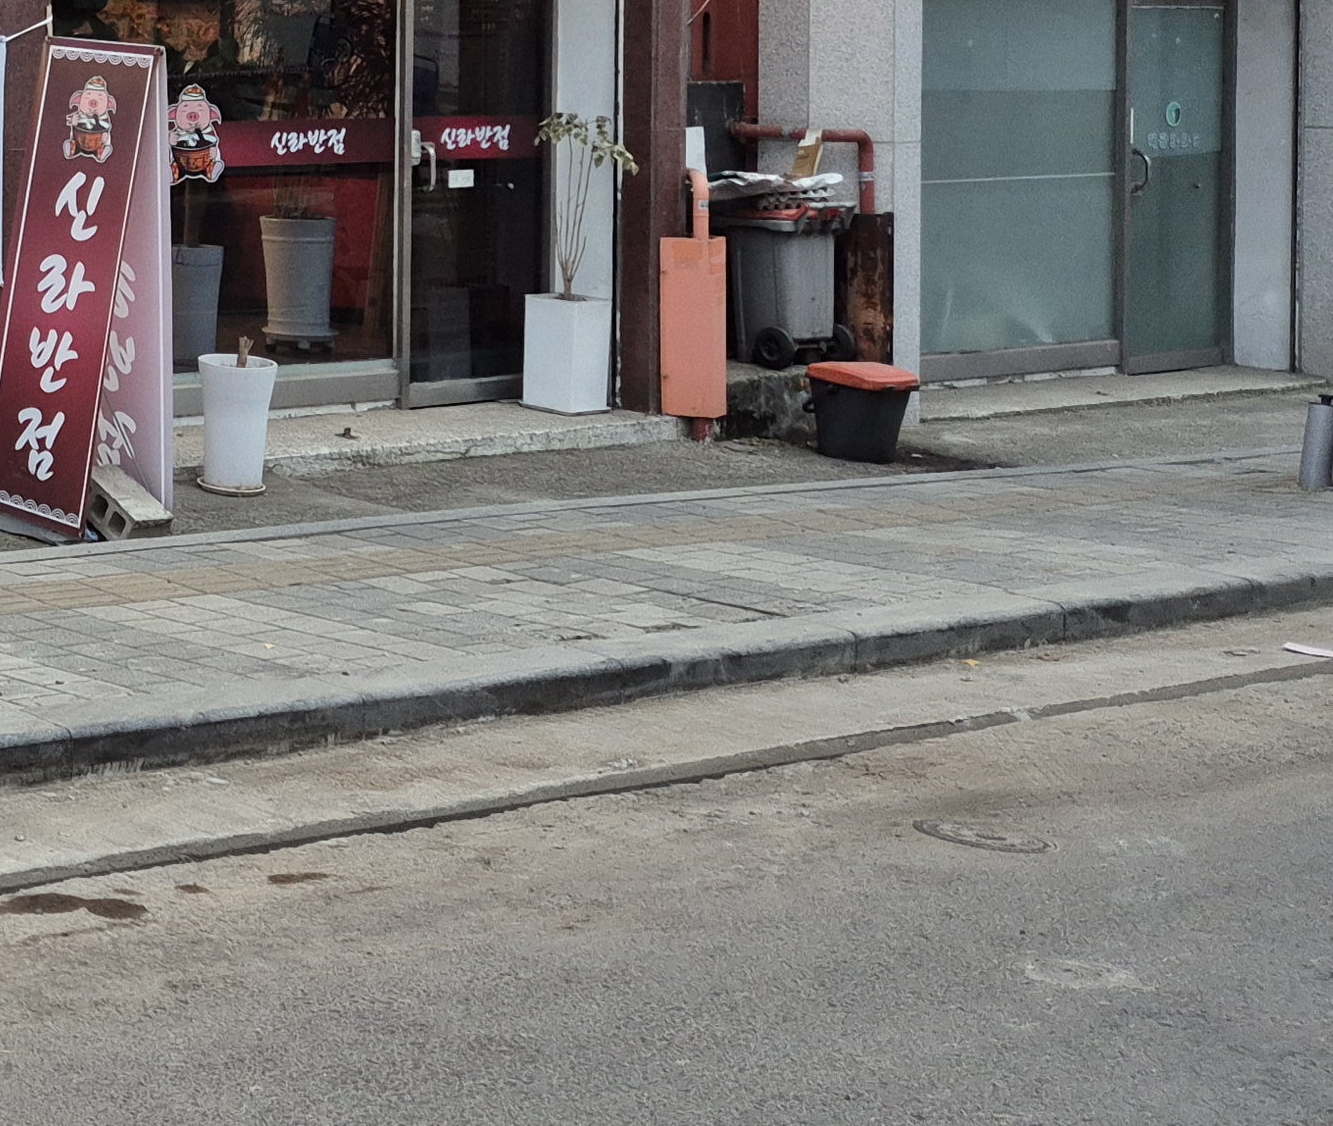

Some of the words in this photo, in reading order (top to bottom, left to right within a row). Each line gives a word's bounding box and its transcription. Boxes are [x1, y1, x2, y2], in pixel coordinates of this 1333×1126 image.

[270, 127, 347, 156] 신라반점
[440, 124, 511, 151] 신라반점
[14, 171, 106, 482] 신라반점
